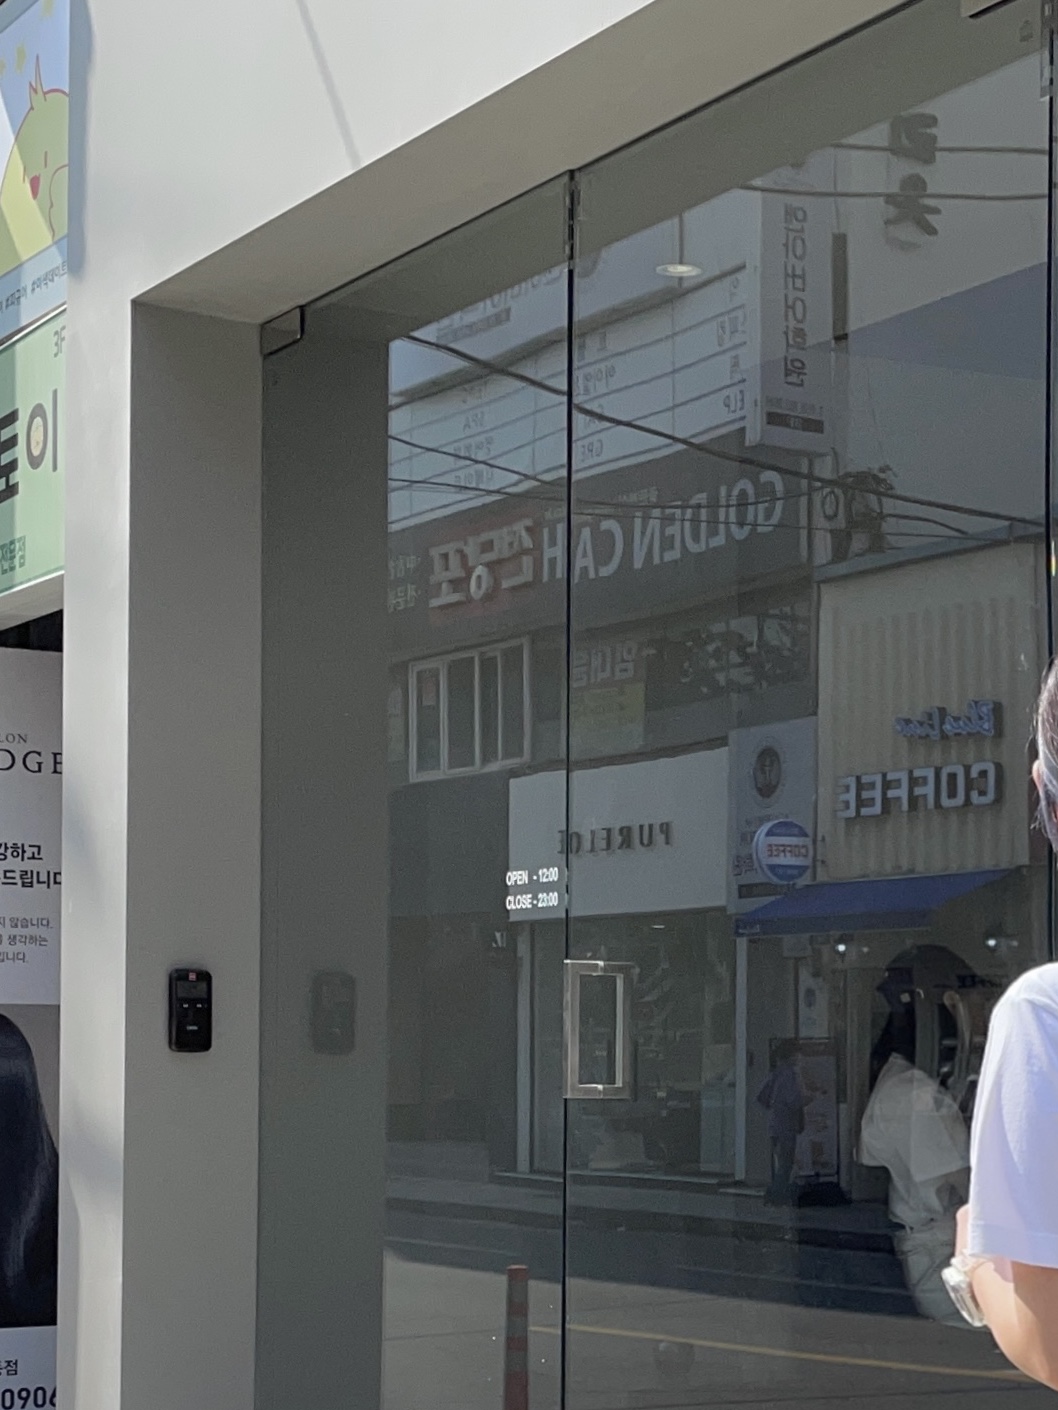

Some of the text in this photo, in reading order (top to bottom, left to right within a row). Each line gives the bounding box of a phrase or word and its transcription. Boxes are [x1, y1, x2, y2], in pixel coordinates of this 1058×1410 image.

[505, 870, 529, 886] OPEN
[505, 893, 533, 910] CLOSE
[0, 1358, 18, 1377] 점
